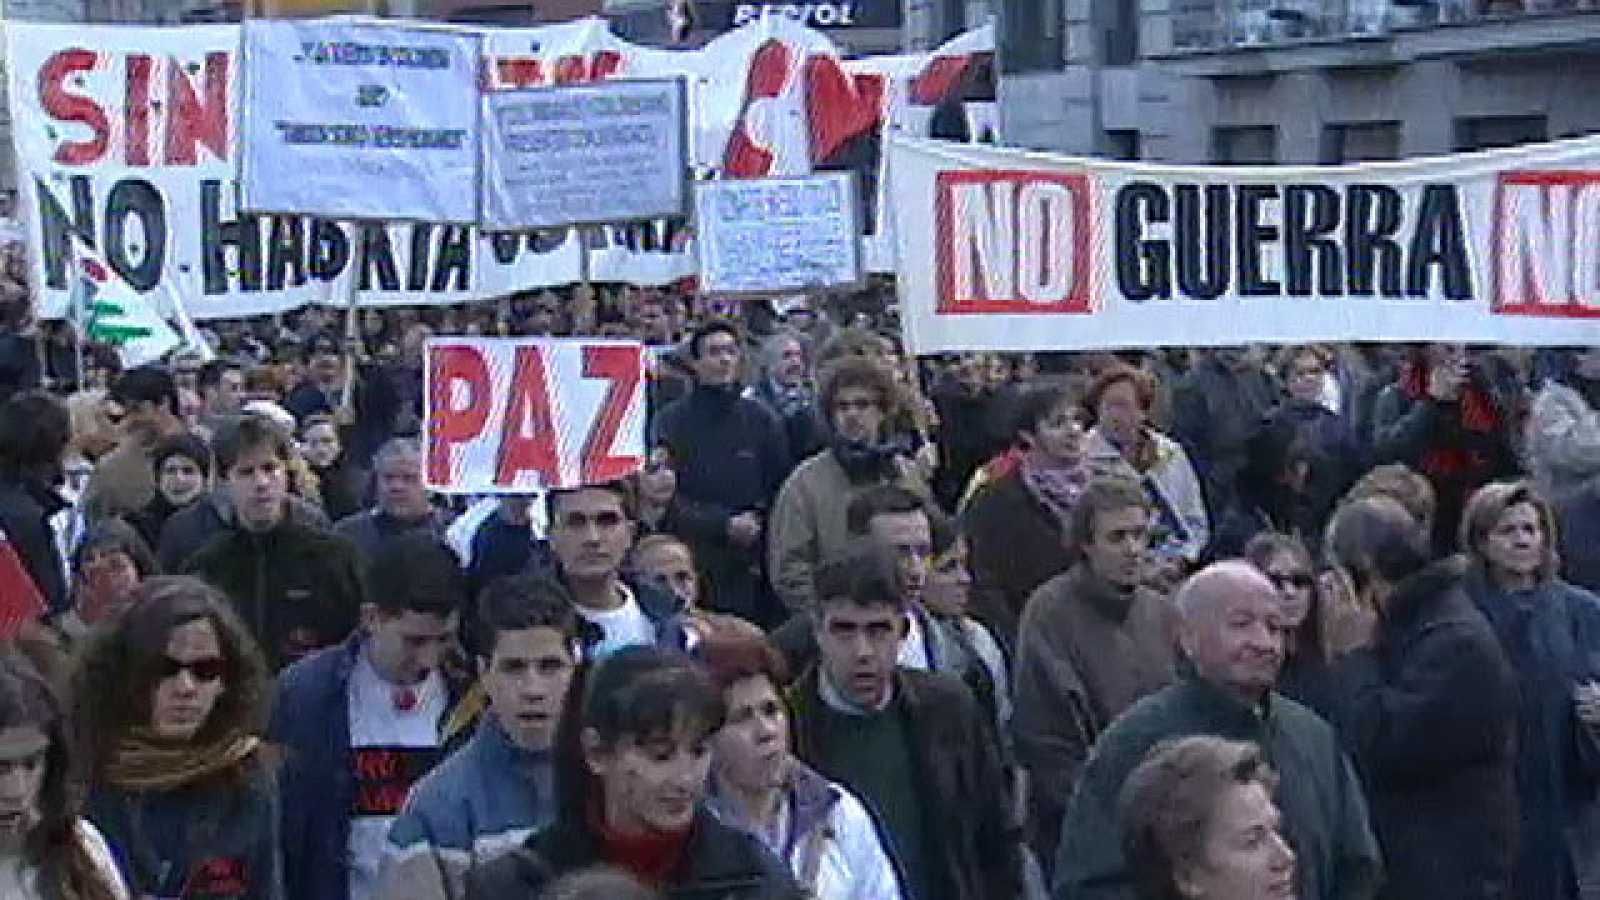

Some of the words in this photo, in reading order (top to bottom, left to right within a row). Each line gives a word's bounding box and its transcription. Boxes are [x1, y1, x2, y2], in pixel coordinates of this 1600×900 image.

[38, 48, 229, 166] SIN
[34, 174, 166, 292] NO
[947, 178, 1079, 306] NO
[1113, 181, 1475, 301] GUERRA
[429, 345, 646, 485] PAZ
